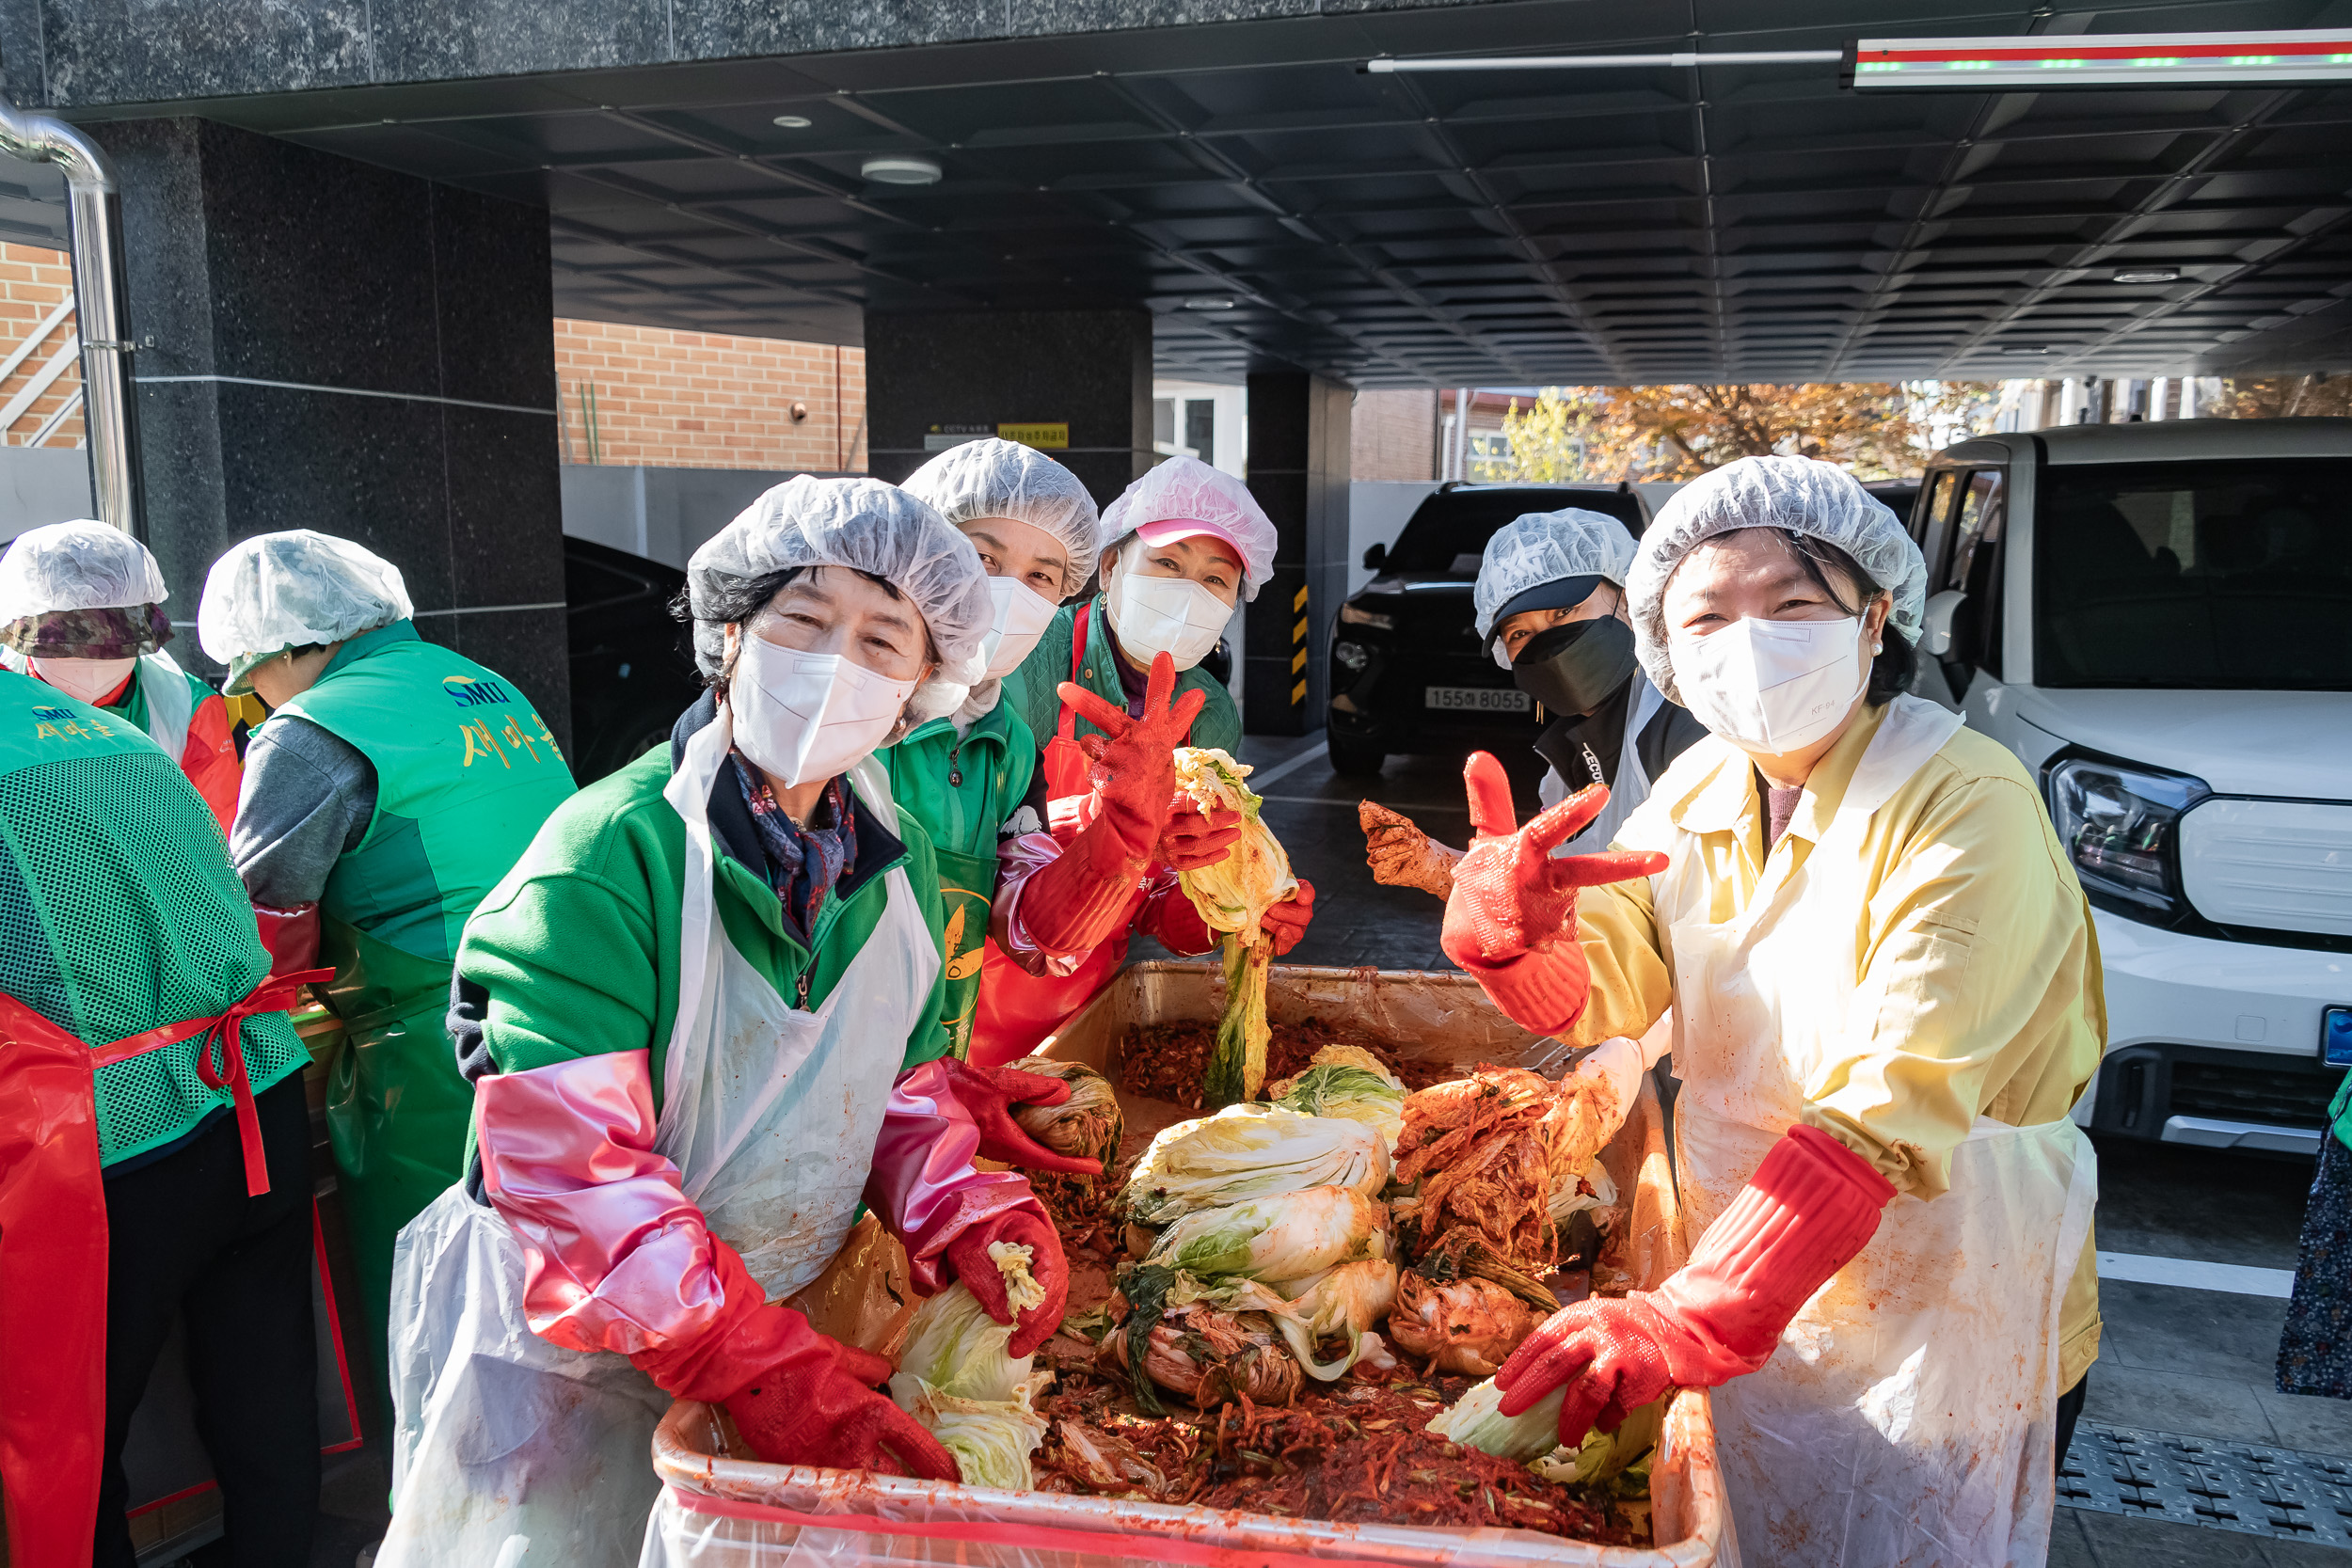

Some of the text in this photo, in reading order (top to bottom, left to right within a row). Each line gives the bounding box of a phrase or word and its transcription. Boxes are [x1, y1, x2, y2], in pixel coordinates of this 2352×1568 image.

[442, 675, 512, 706] SMU
[1480, 691, 1523, 708] 8055
[1811, 699, 1836, 716] KF-94
[31, 705, 78, 721] SMU
[35, 720, 115, 742] 새마을
